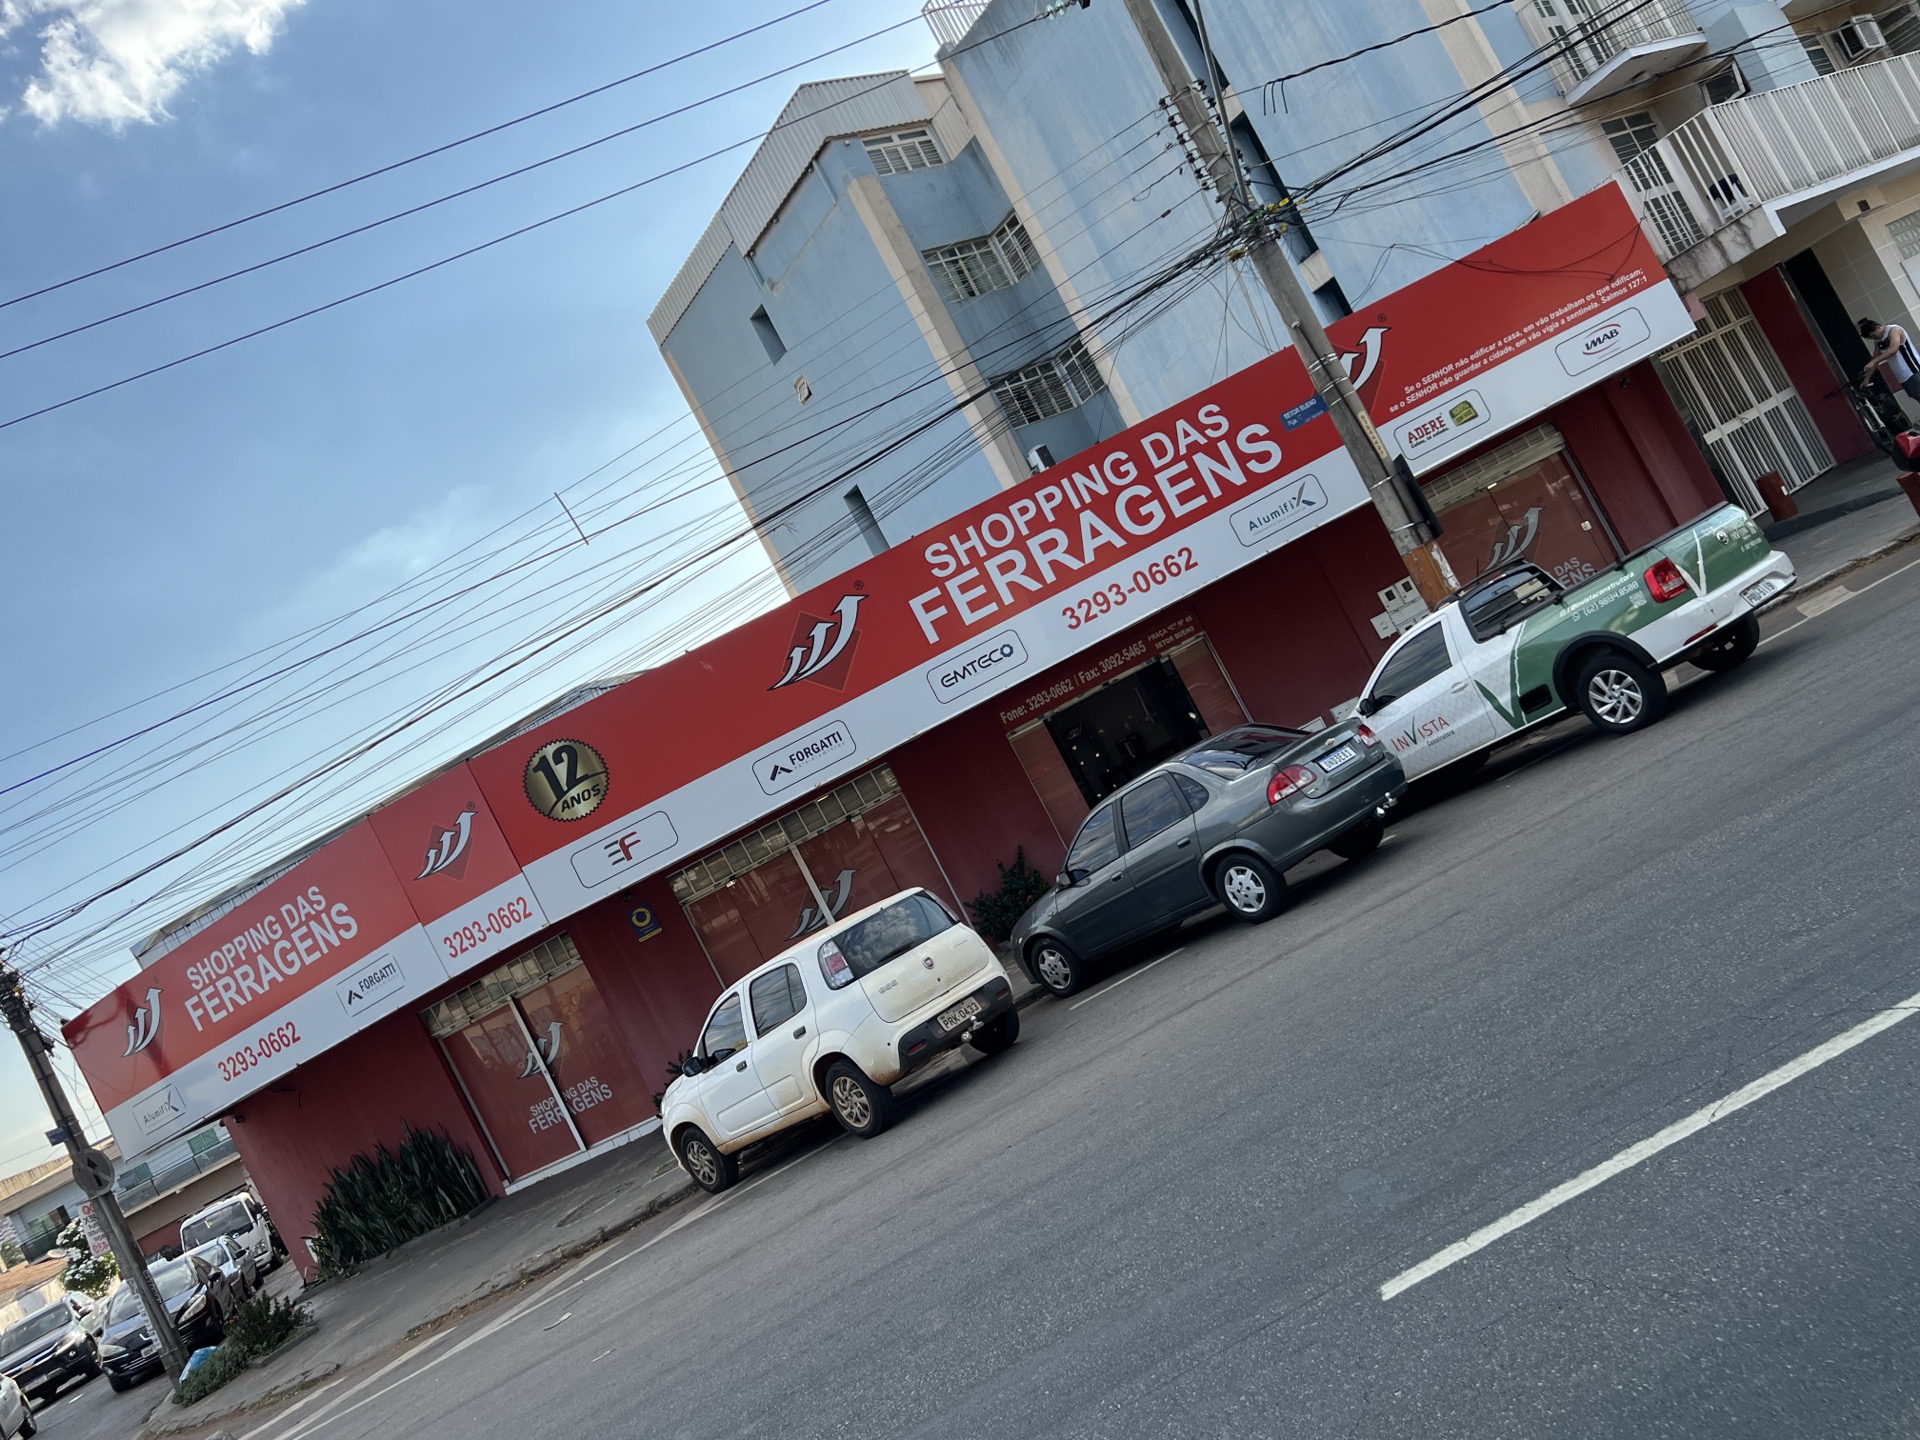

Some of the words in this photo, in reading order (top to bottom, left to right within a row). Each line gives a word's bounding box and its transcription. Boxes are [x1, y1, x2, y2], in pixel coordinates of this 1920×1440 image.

[1389, 404, 1399, 413] se
[1405, 382, 1438, 404] SENHOR
[1439, 376, 1453, 387] não
[1453, 360, 1481, 381] guardar
[1488, 345, 1515, 361] cidade,
[1515, 338, 1527, 348] em
[1527, 331, 1541, 342] vão
[1541, 320, 1560, 334] vigia
[1566, 302, 1600, 321] sentinela.
[1600, 287, 1628, 304] Salmos
[1628, 275, 1648, 290] 127:1
[1404, 384, 1415, 394] Se
[1421, 363, 1454, 385] SENHOR
[1455, 357, 1470, 368] não
[1469, 343, 1496, 360] edificar
[1503, 330, 1523, 343] casa,
[1523, 323, 1535, 333] em
[1535, 316, 1549, 327] vão
[1549, 297, 1585, 320] trabalham
[1586, 292, 1596, 301] os
[1596, 285, 1610, 297] que
[1408, 415, 1447, 444] ADERE
[924, 451, 1137, 578] SHOPPING
[1141, 404, 1230, 469] DAS
[908, 423, 1283, 645] FERRAGENS
[1061, 547, 1199, 631] 3293-0662
[1553, 556, 1580, 577] DAS
[1154, 635, 1175, 650] SETOR
[1173, 625, 1195, 640] BUENO
[1583, 601, 1599, 616] (62)
[999, 703, 1028, 725] Fone:
[1025, 679, 1075, 712] 3293-0662
[1076, 663, 1101, 685] Fax:
[1098, 640, 1147, 673] 3092-5465
[788, 731, 843, 766] FORGATTI
[1391, 714, 1450, 752] INVISTA
[531, 744, 591, 801] 12
[560, 783, 601, 813] ANOS
[186, 915, 283, 990] SHOPPING
[280, 886, 326, 930] DAS
[443, 896, 533, 959] 3293-0662
[184, 902, 358, 1032] FERRAGENS
[358, 962, 397, 992] FORGATTI
[217, 1021, 301, 1082] 3293-0662
[576, 1076, 599, 1094] DAS
